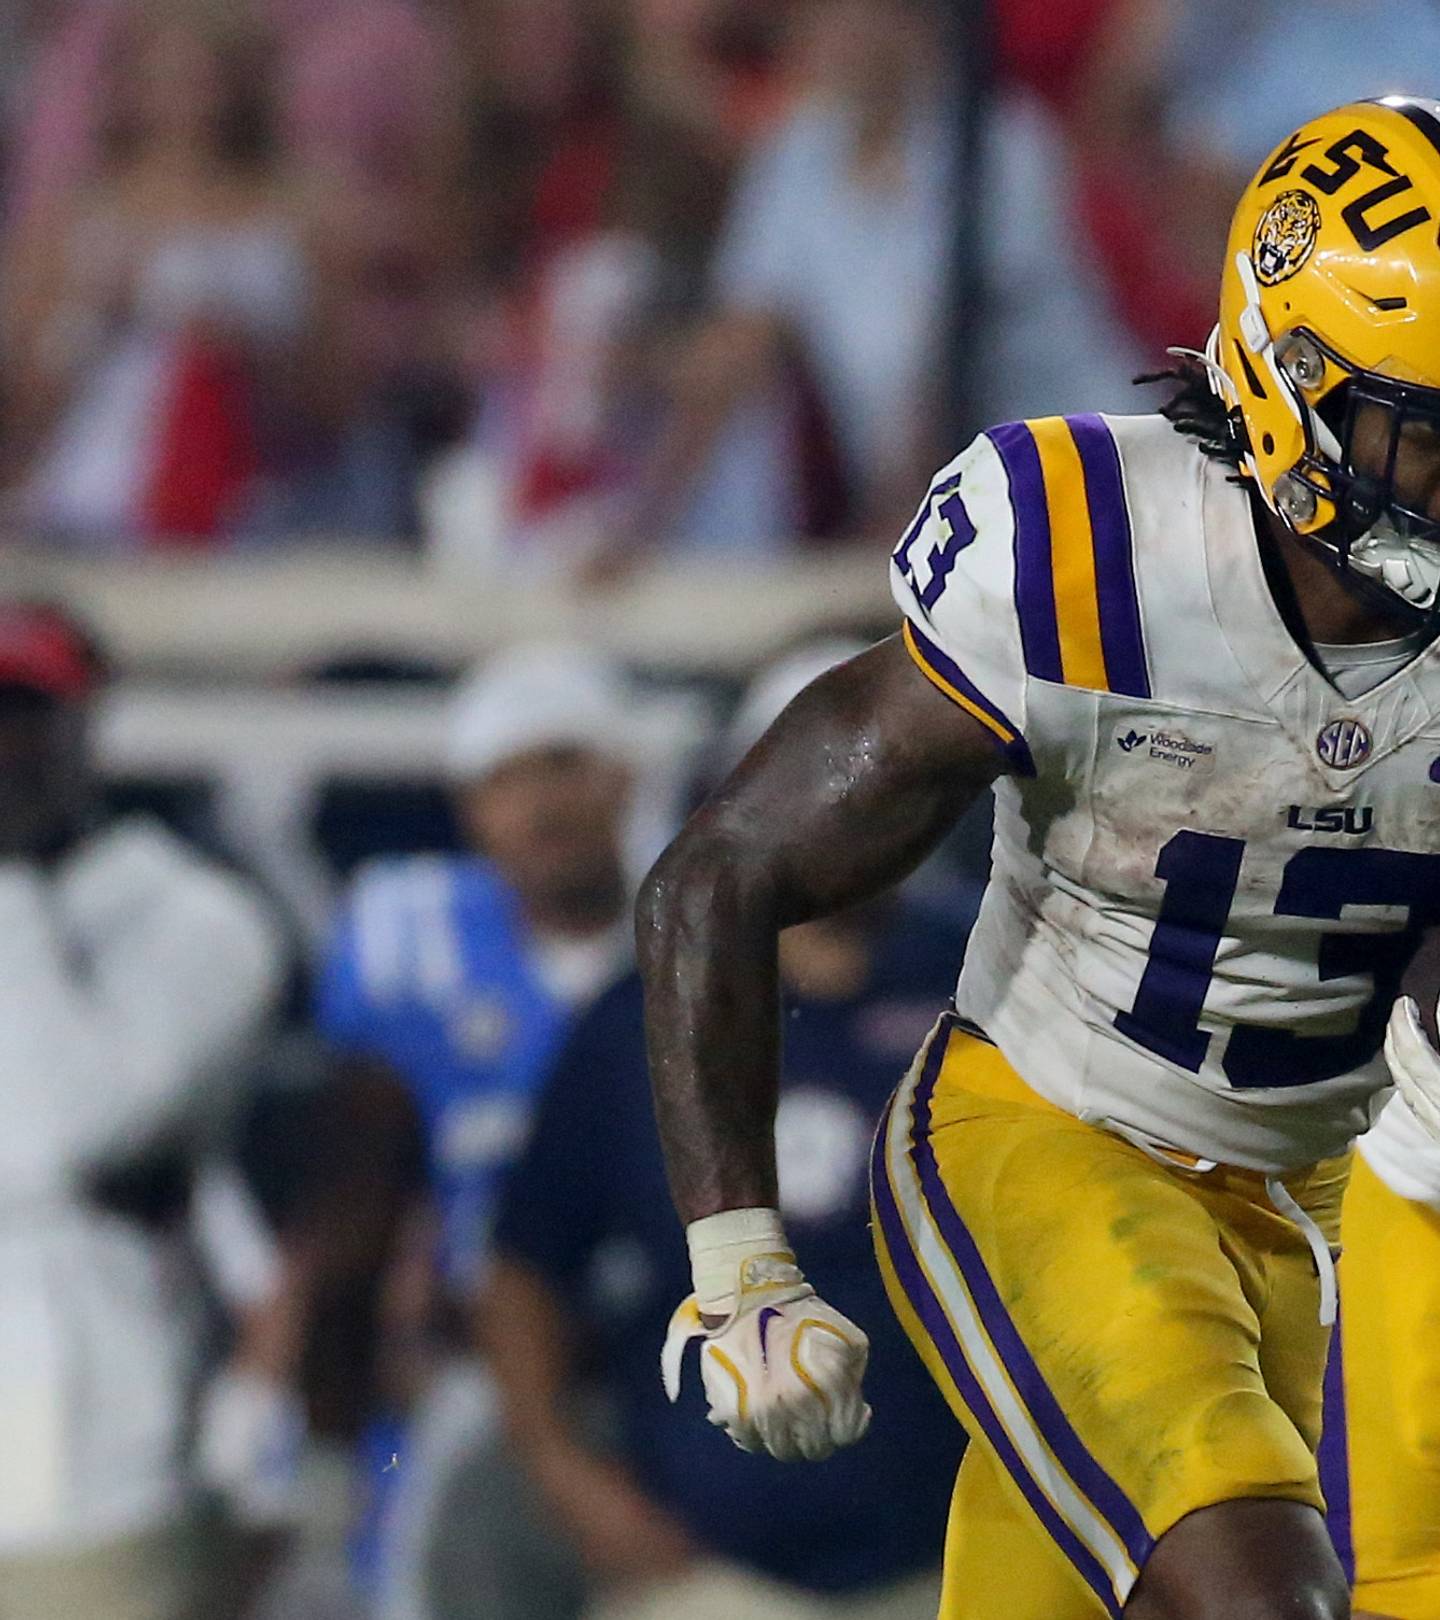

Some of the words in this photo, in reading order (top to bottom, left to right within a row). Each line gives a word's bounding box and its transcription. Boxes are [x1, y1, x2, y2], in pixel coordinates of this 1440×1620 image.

[1258, 129, 1432, 251] LSU
[892, 472, 977, 611] 13
[1149, 746, 1196, 768] Energy
[1150, 733, 1213, 755] Woodside
[1318, 720, 1372, 768] SEC
[1286, 804, 1373, 834] LSU
